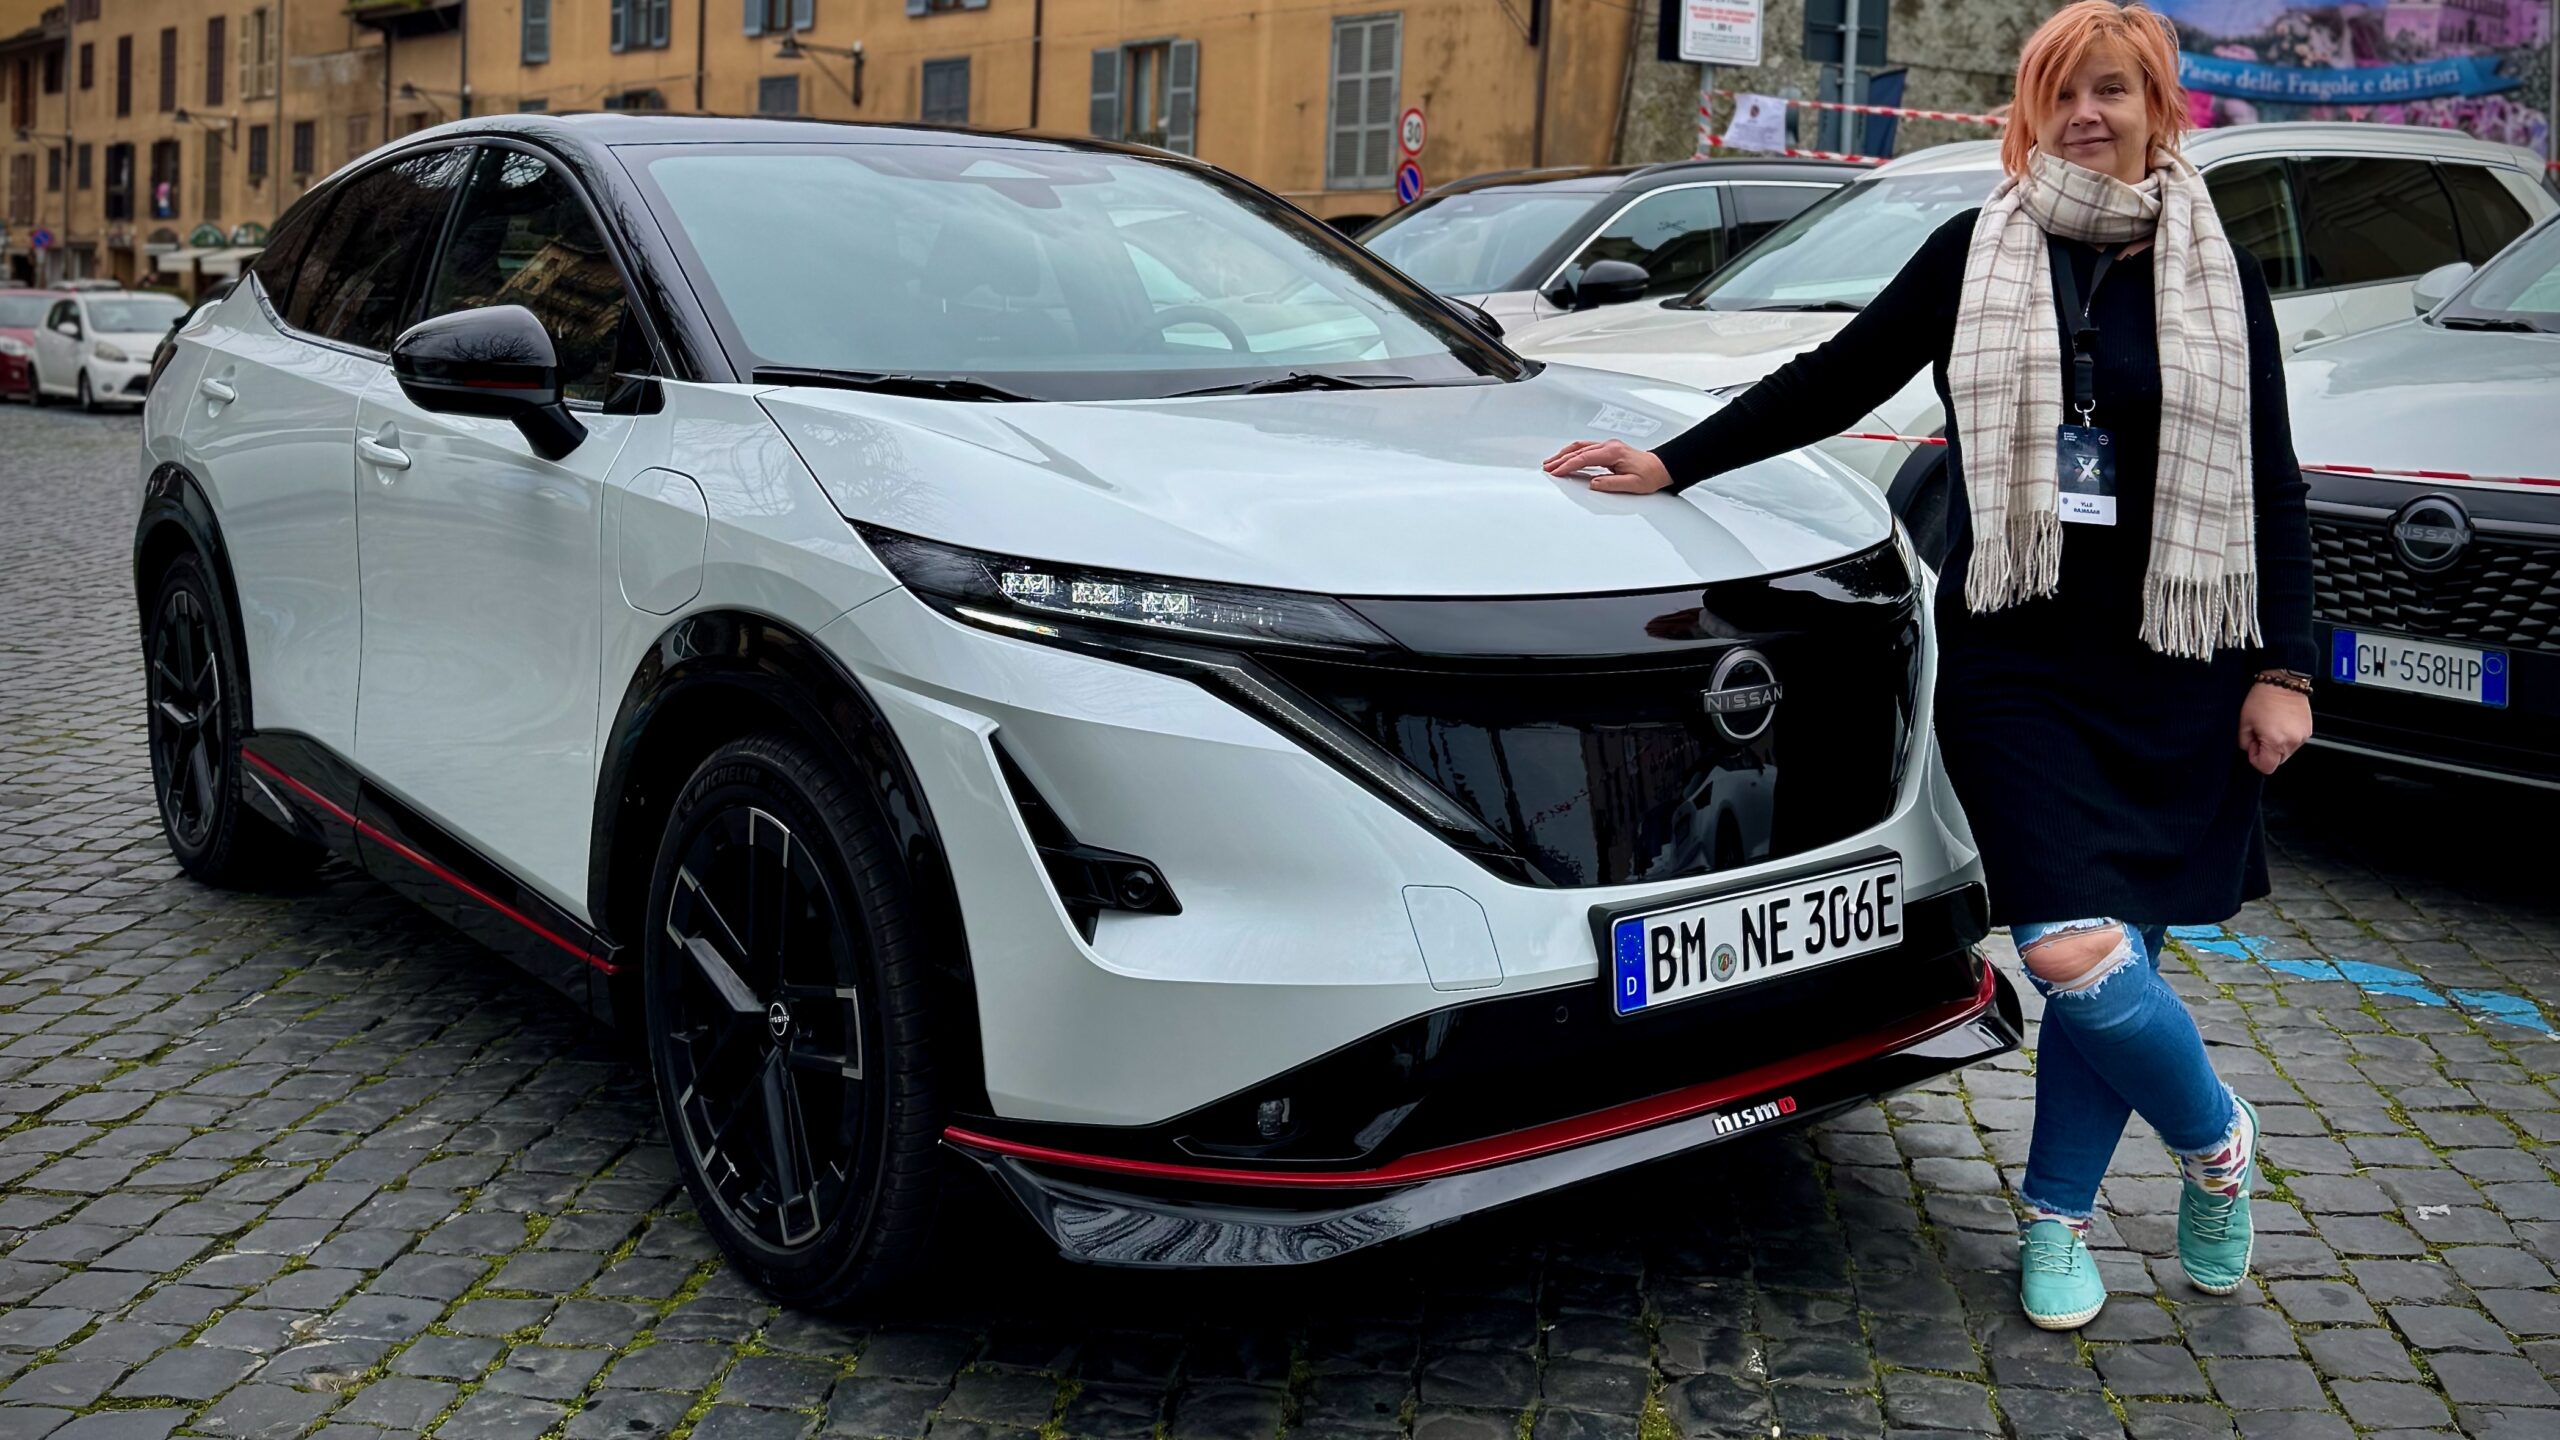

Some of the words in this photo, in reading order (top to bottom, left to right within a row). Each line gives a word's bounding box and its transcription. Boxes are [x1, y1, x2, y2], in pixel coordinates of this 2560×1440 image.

[2179, 57, 2230, 86] Paese
[2236, 69, 2281, 92] delle
[2288, 76, 2360, 100] Fragole
[2363, 80, 2375, 93] e
[2380, 72, 2409, 92] dei
[2414, 64, 2460, 88] Fiori
[1405, 120, 1421, 144] 30
[2395, 524, 2468, 543] NISSAN
[2357, 644, 2387, 678] GW
[2400, 650, 2482, 692] 558HP
[1707, 685, 1783, 712] NISSAN
[695, 766, 761, 801] MICHELIN
[1626, 976, 1638, 996] D
[1650, 916, 1707, 993] BM
[1741, 897, 1794, 972] NE
[1803, 873, 1899, 955] 306E
[1713, 1096, 1797, 1135] nismo
